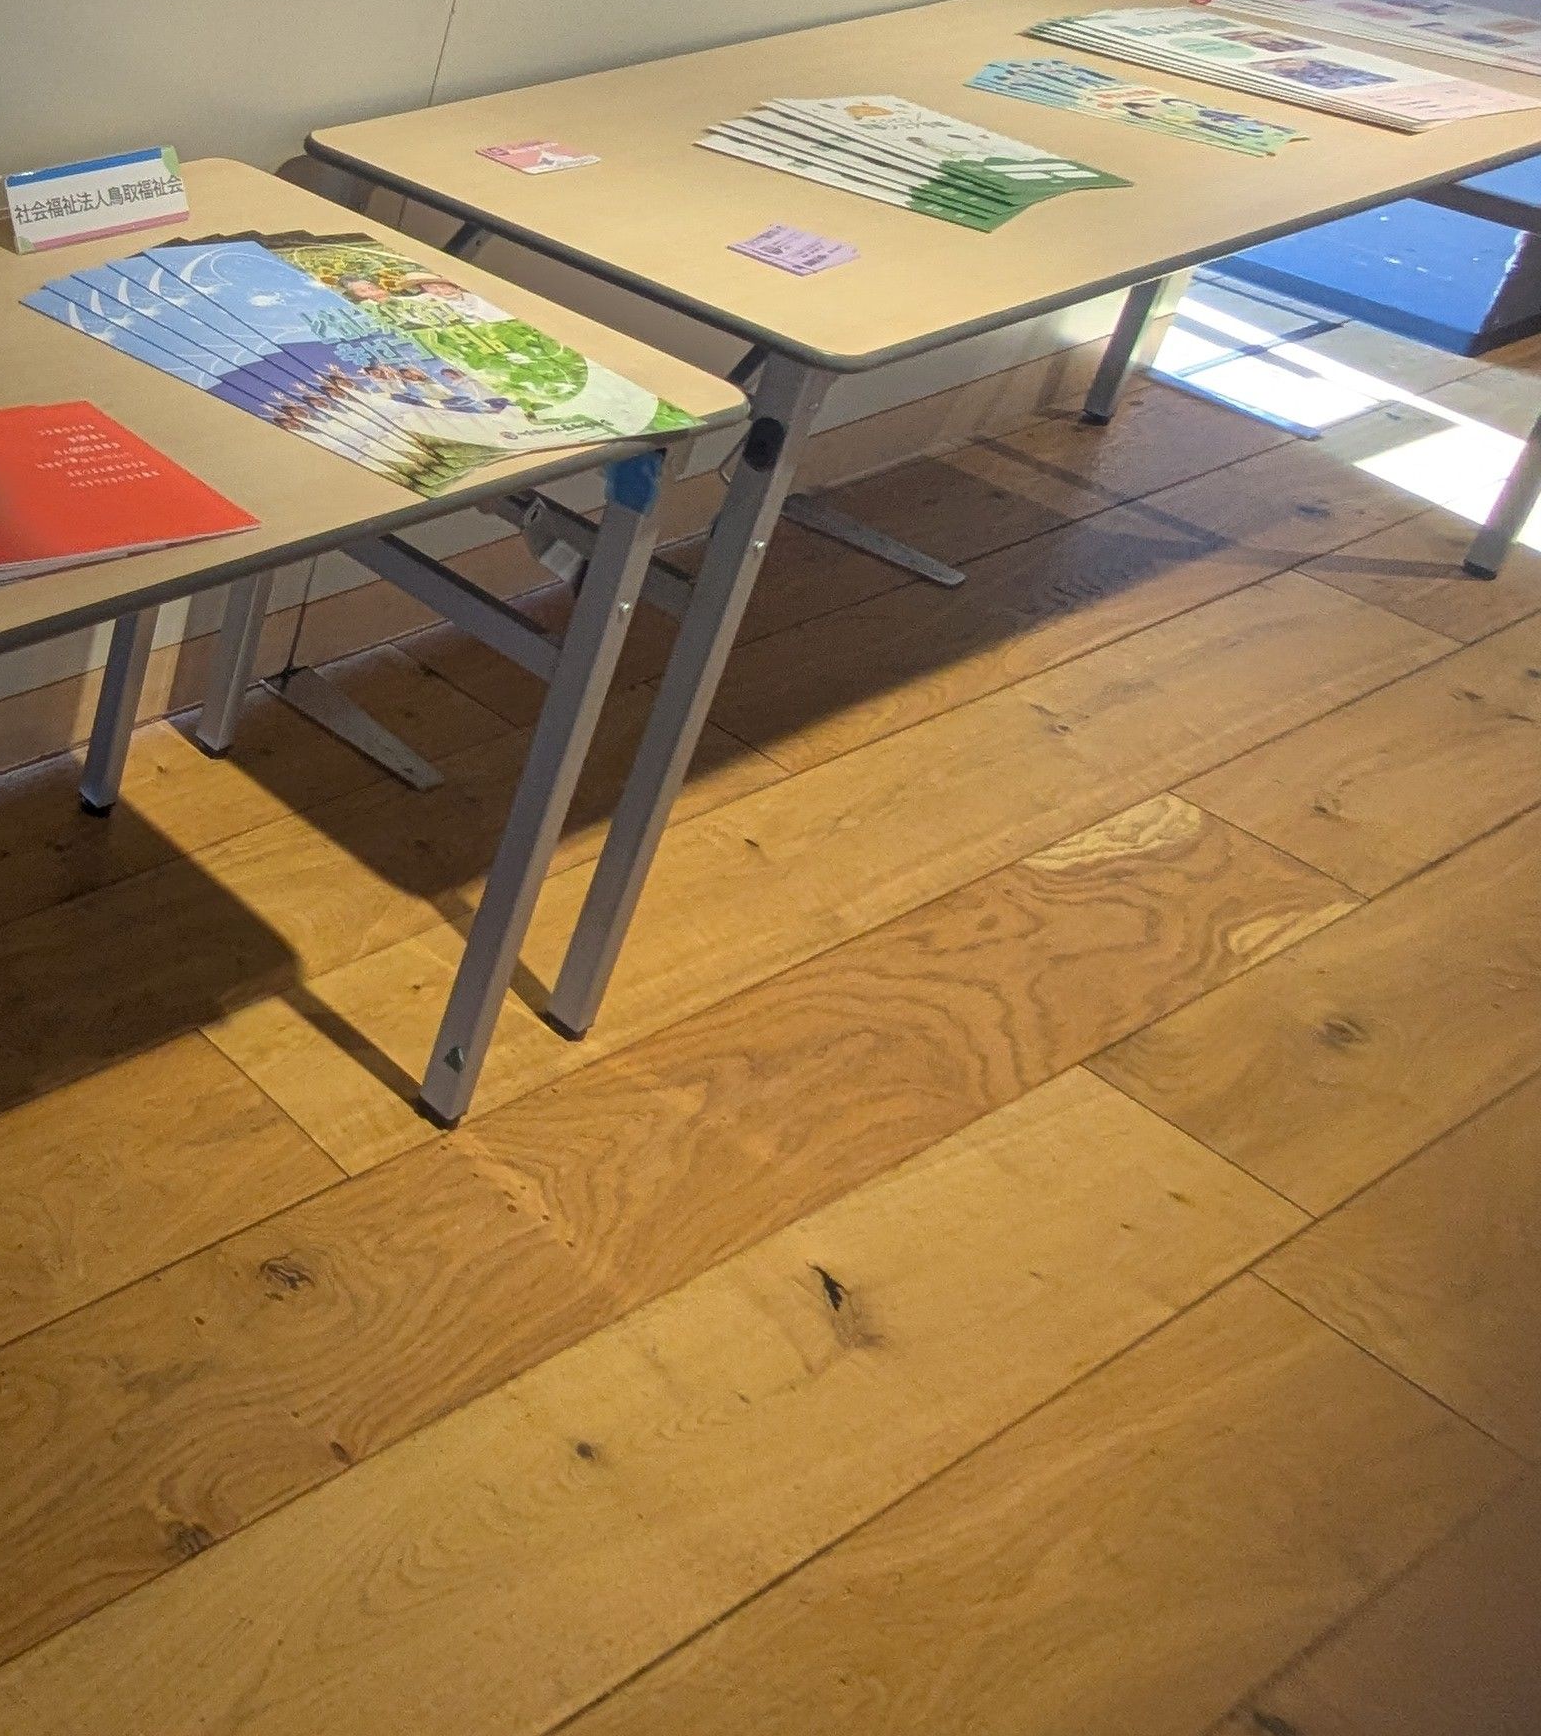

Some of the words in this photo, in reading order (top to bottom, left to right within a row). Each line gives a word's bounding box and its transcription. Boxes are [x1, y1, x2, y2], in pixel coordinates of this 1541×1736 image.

[13, 174, 184, 226] 社会福祉法人鳥取福祉会
